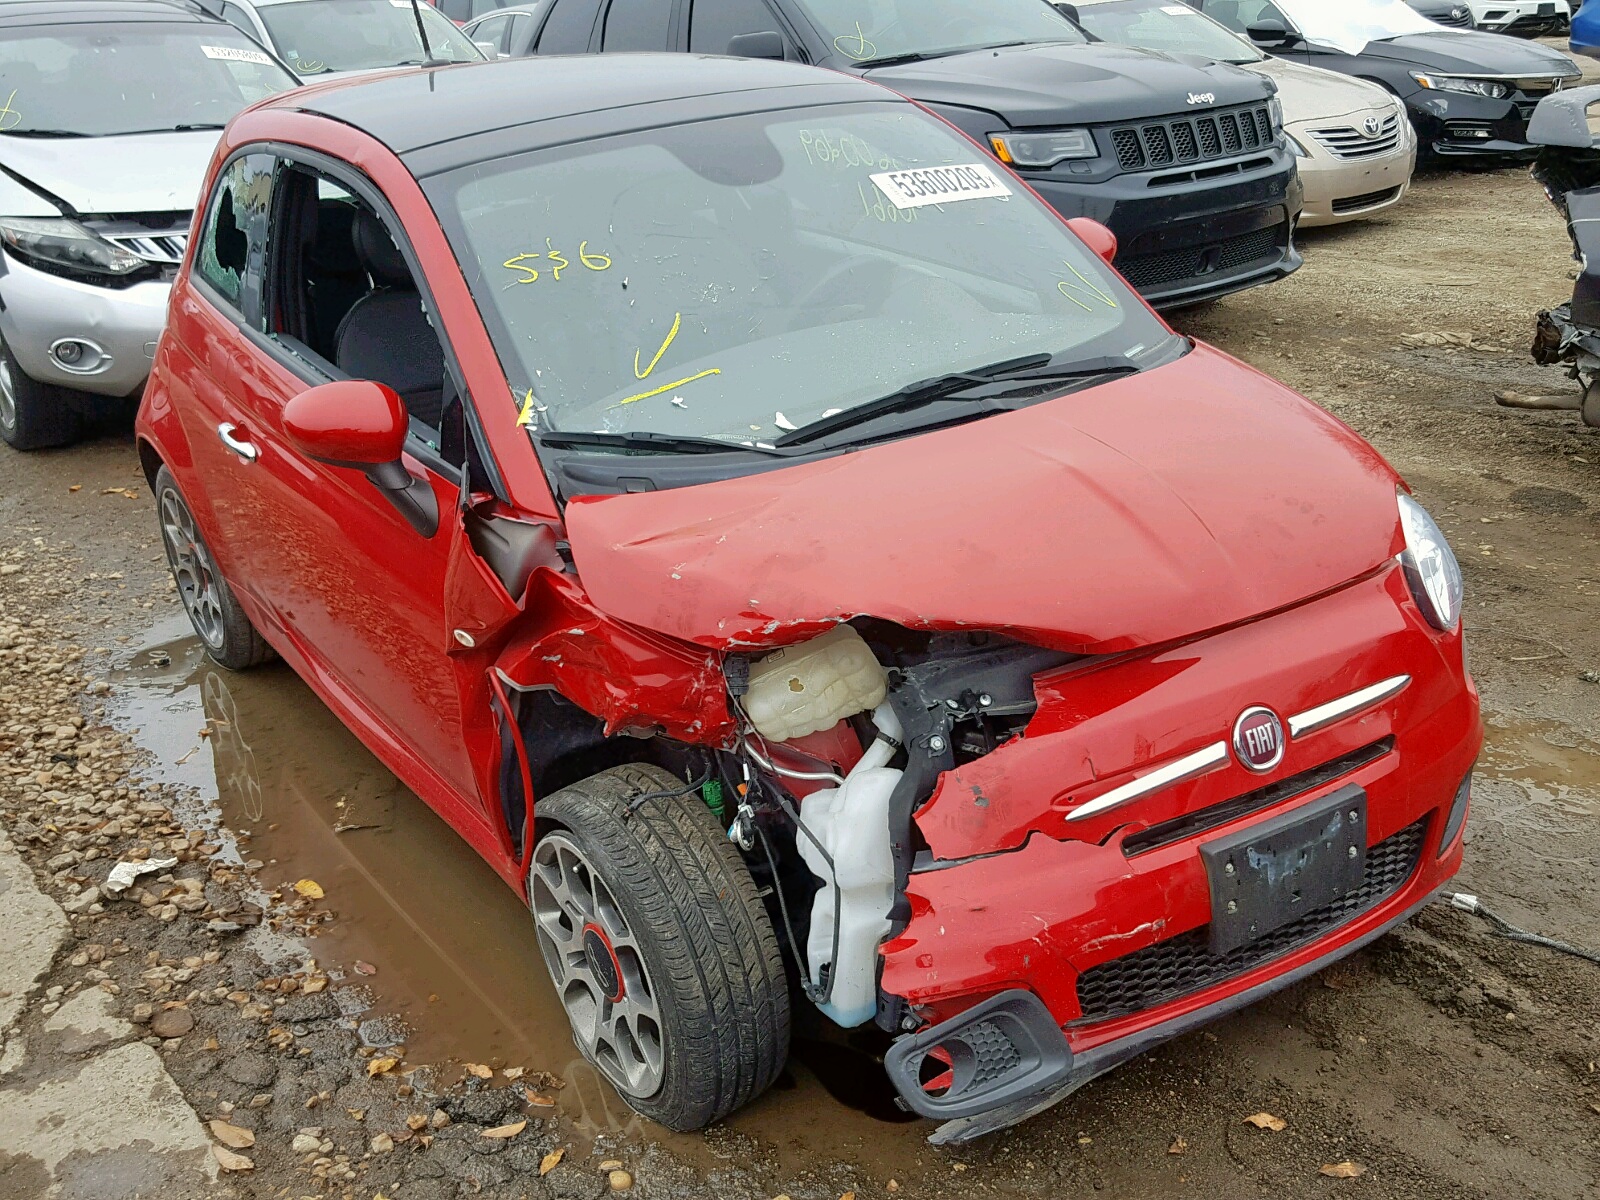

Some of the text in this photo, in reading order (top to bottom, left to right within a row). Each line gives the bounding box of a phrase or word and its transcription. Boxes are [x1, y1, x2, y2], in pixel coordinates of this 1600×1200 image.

[1186, 92, 1215, 105] Jeep
[888, 166, 990, 198] 53600209
[1245, 722, 1275, 757] FIAT
